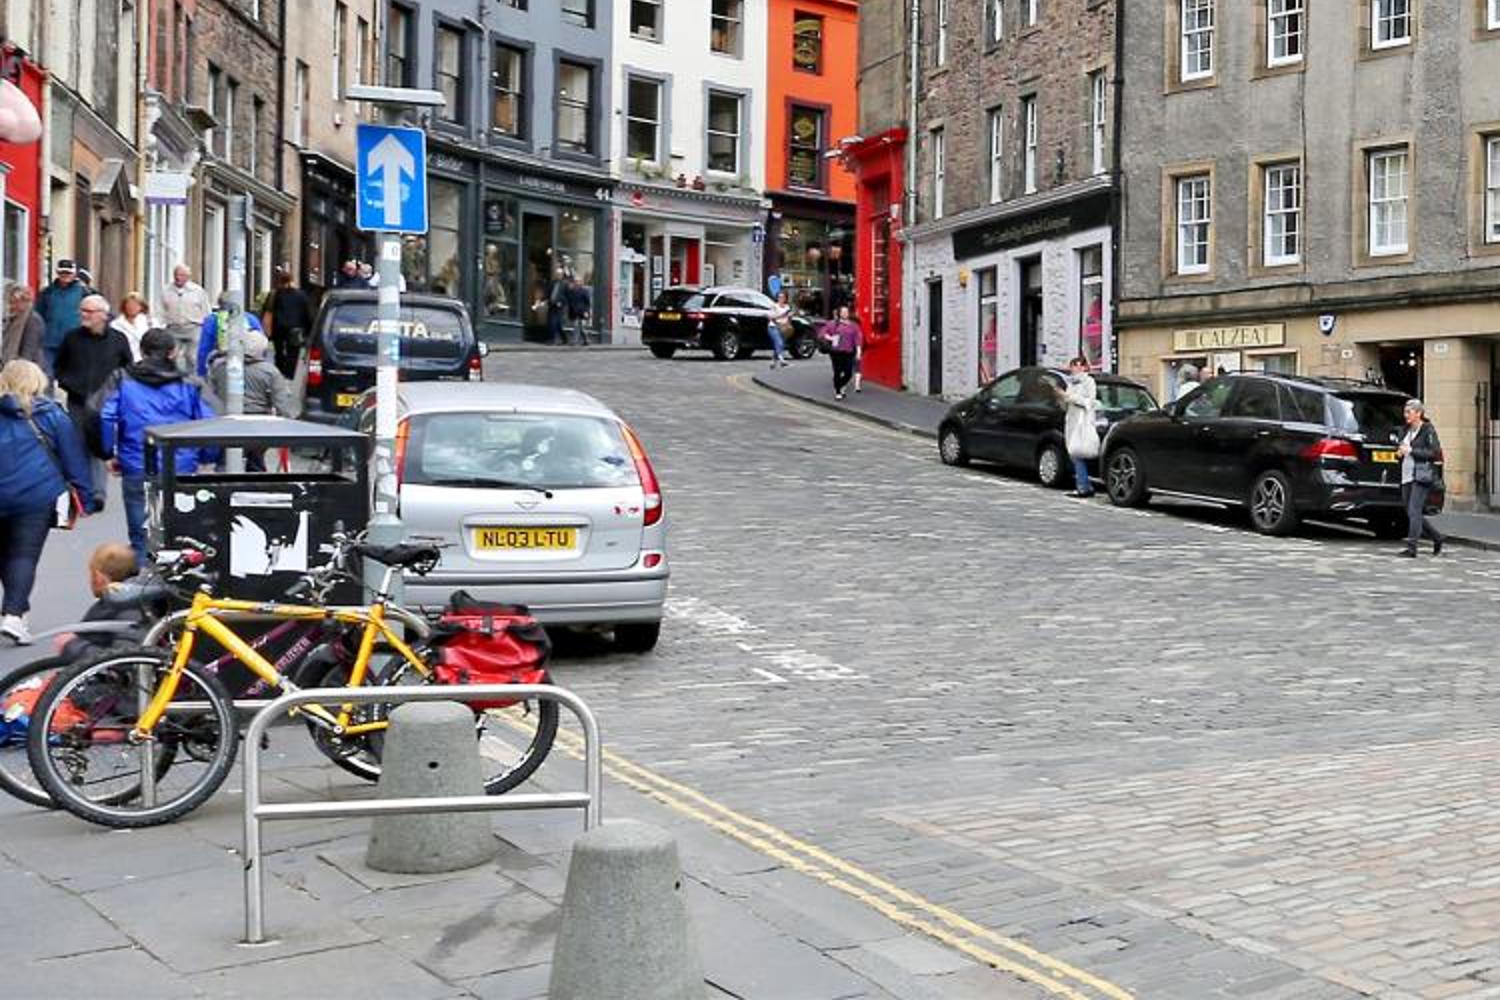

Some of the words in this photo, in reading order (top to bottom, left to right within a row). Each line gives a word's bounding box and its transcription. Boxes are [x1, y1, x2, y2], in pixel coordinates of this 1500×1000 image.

[1199, 327, 1272, 347] CALZEAT
[483, 531, 529, 548] NL03
[534, 531, 569, 547] LTU
